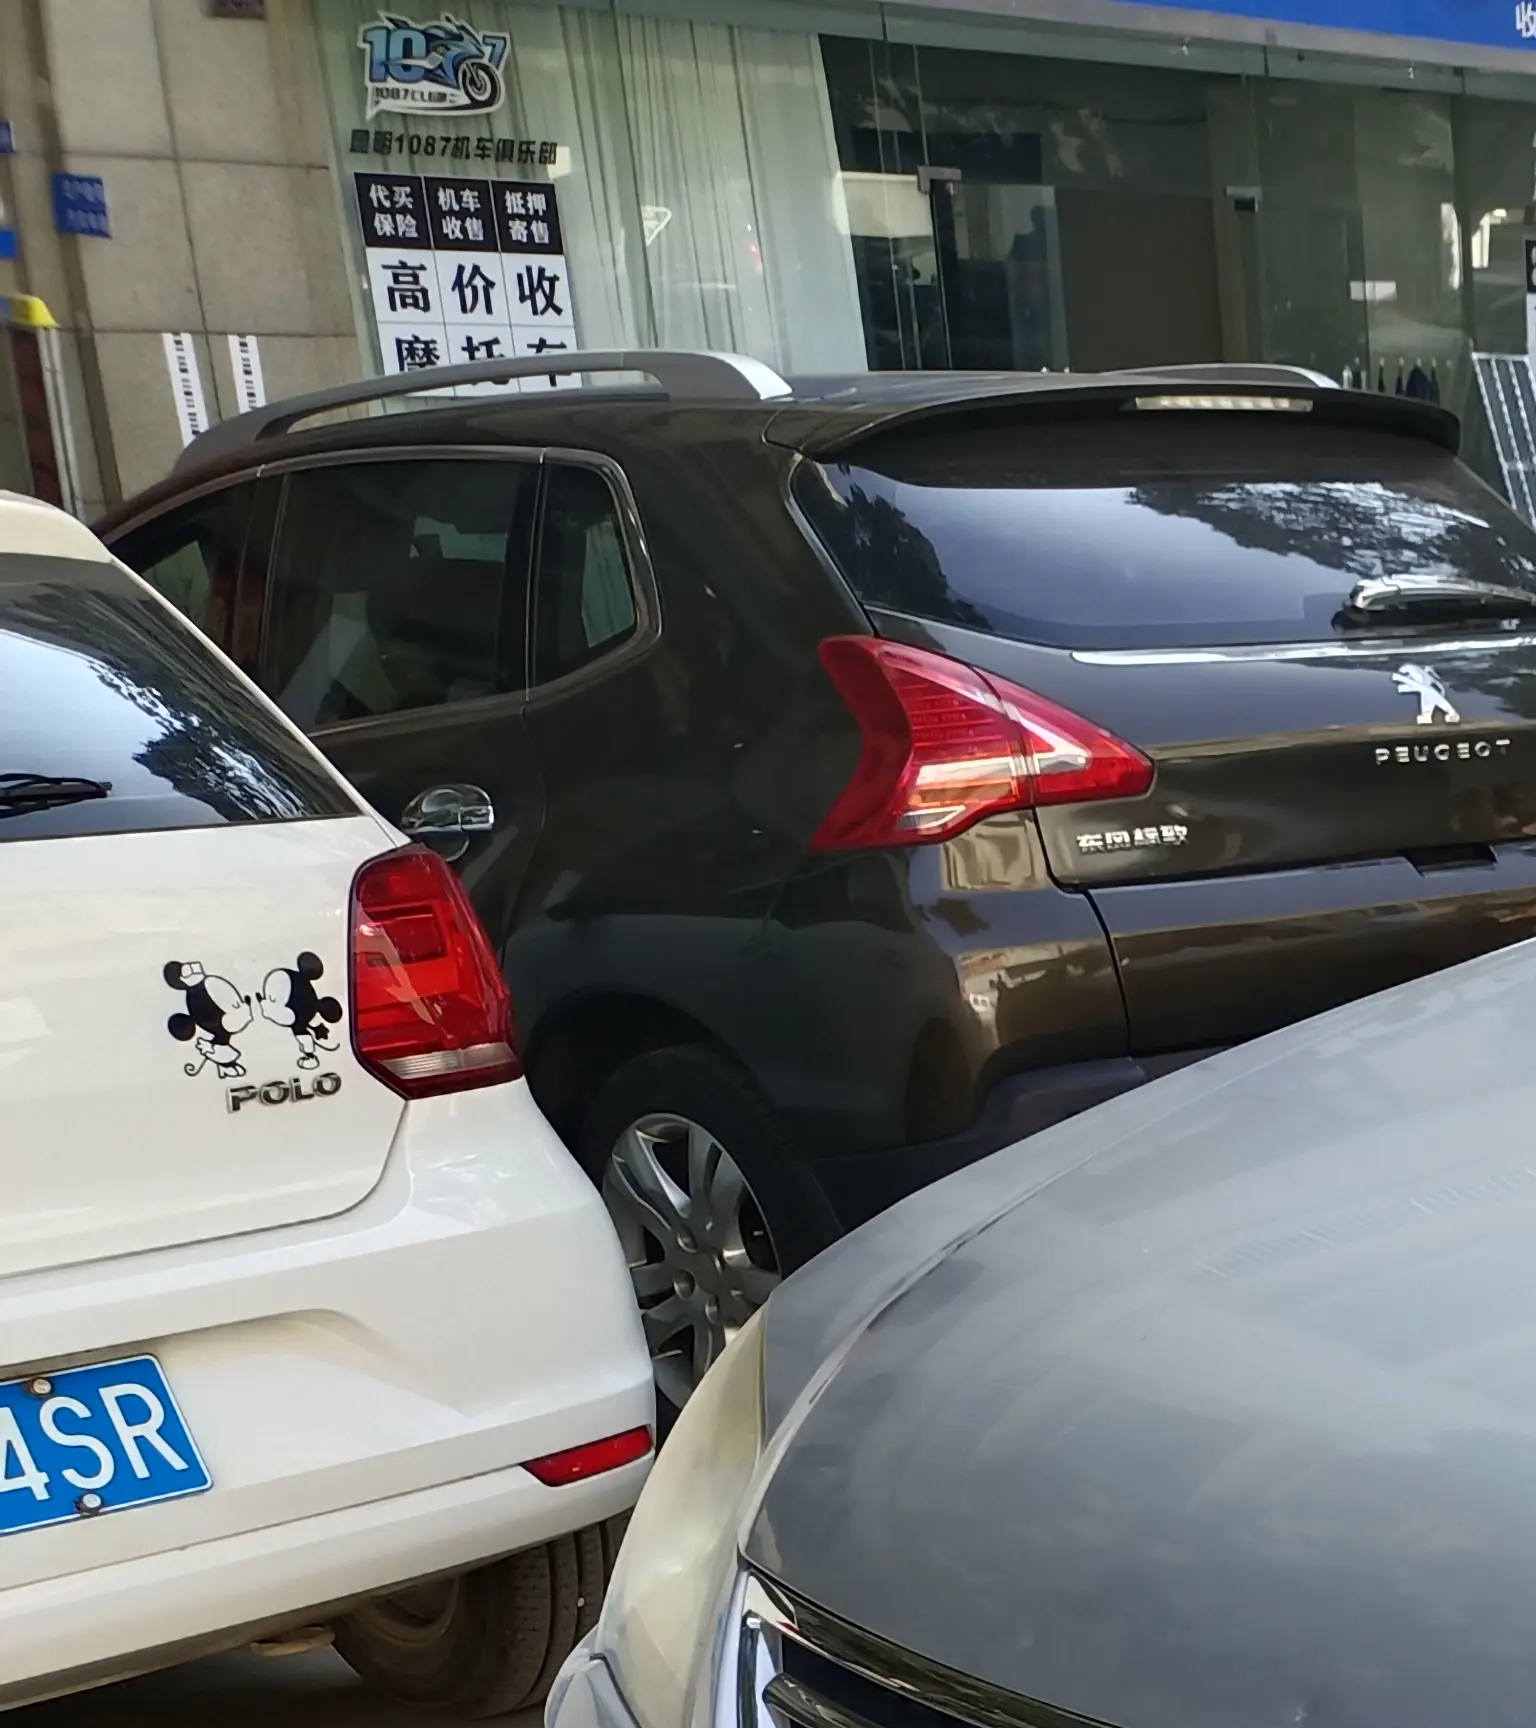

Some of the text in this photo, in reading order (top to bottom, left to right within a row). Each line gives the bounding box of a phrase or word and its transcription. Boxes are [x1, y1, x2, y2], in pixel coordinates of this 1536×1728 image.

[369, 183, 414, 209] 代买
[437, 186, 481, 213] 机车
[504, 190, 548, 217] 抵押
[373, 212, 419, 238] 保险
[442, 216, 485, 242] 收售
[508, 219, 550, 245] 寄售
[381, 259, 564, 317] 高价收
[1375, 738, 1511, 767] PEUGEOT
[226, 1072, 342, 1114] POLO
